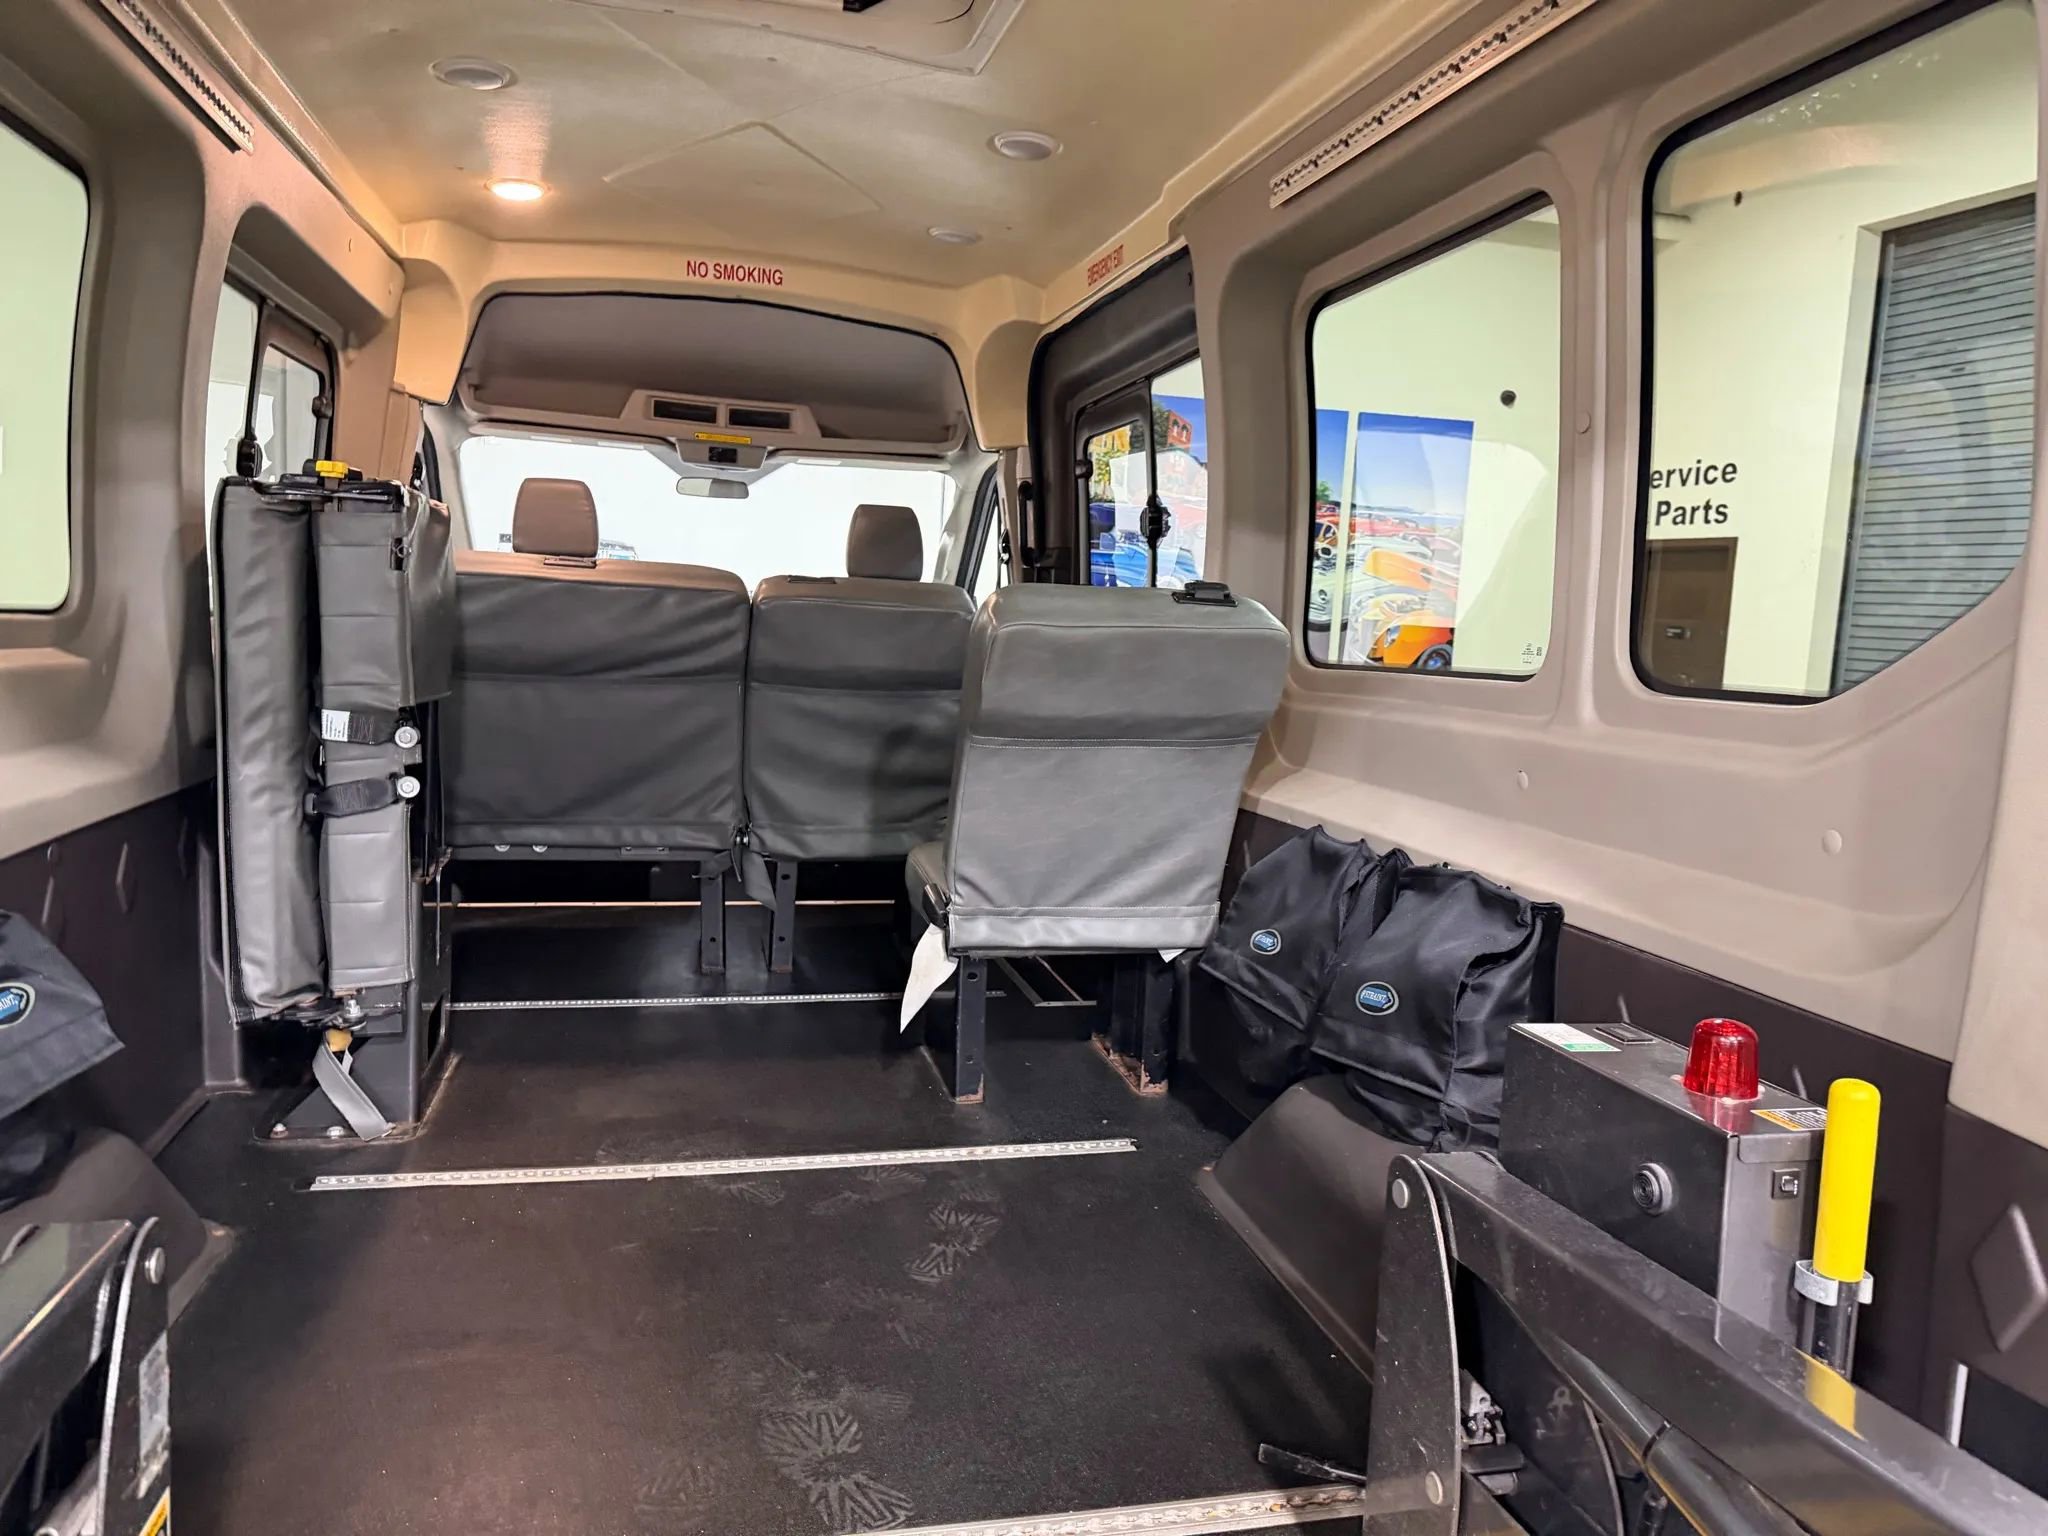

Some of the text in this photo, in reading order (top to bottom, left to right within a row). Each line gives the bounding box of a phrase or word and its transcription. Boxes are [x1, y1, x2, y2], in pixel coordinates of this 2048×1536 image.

[686, 260, 783, 286] NO SMOKING
[1650, 459, 1738, 489] ervice
[1655, 498, 1729, 526] Parts
